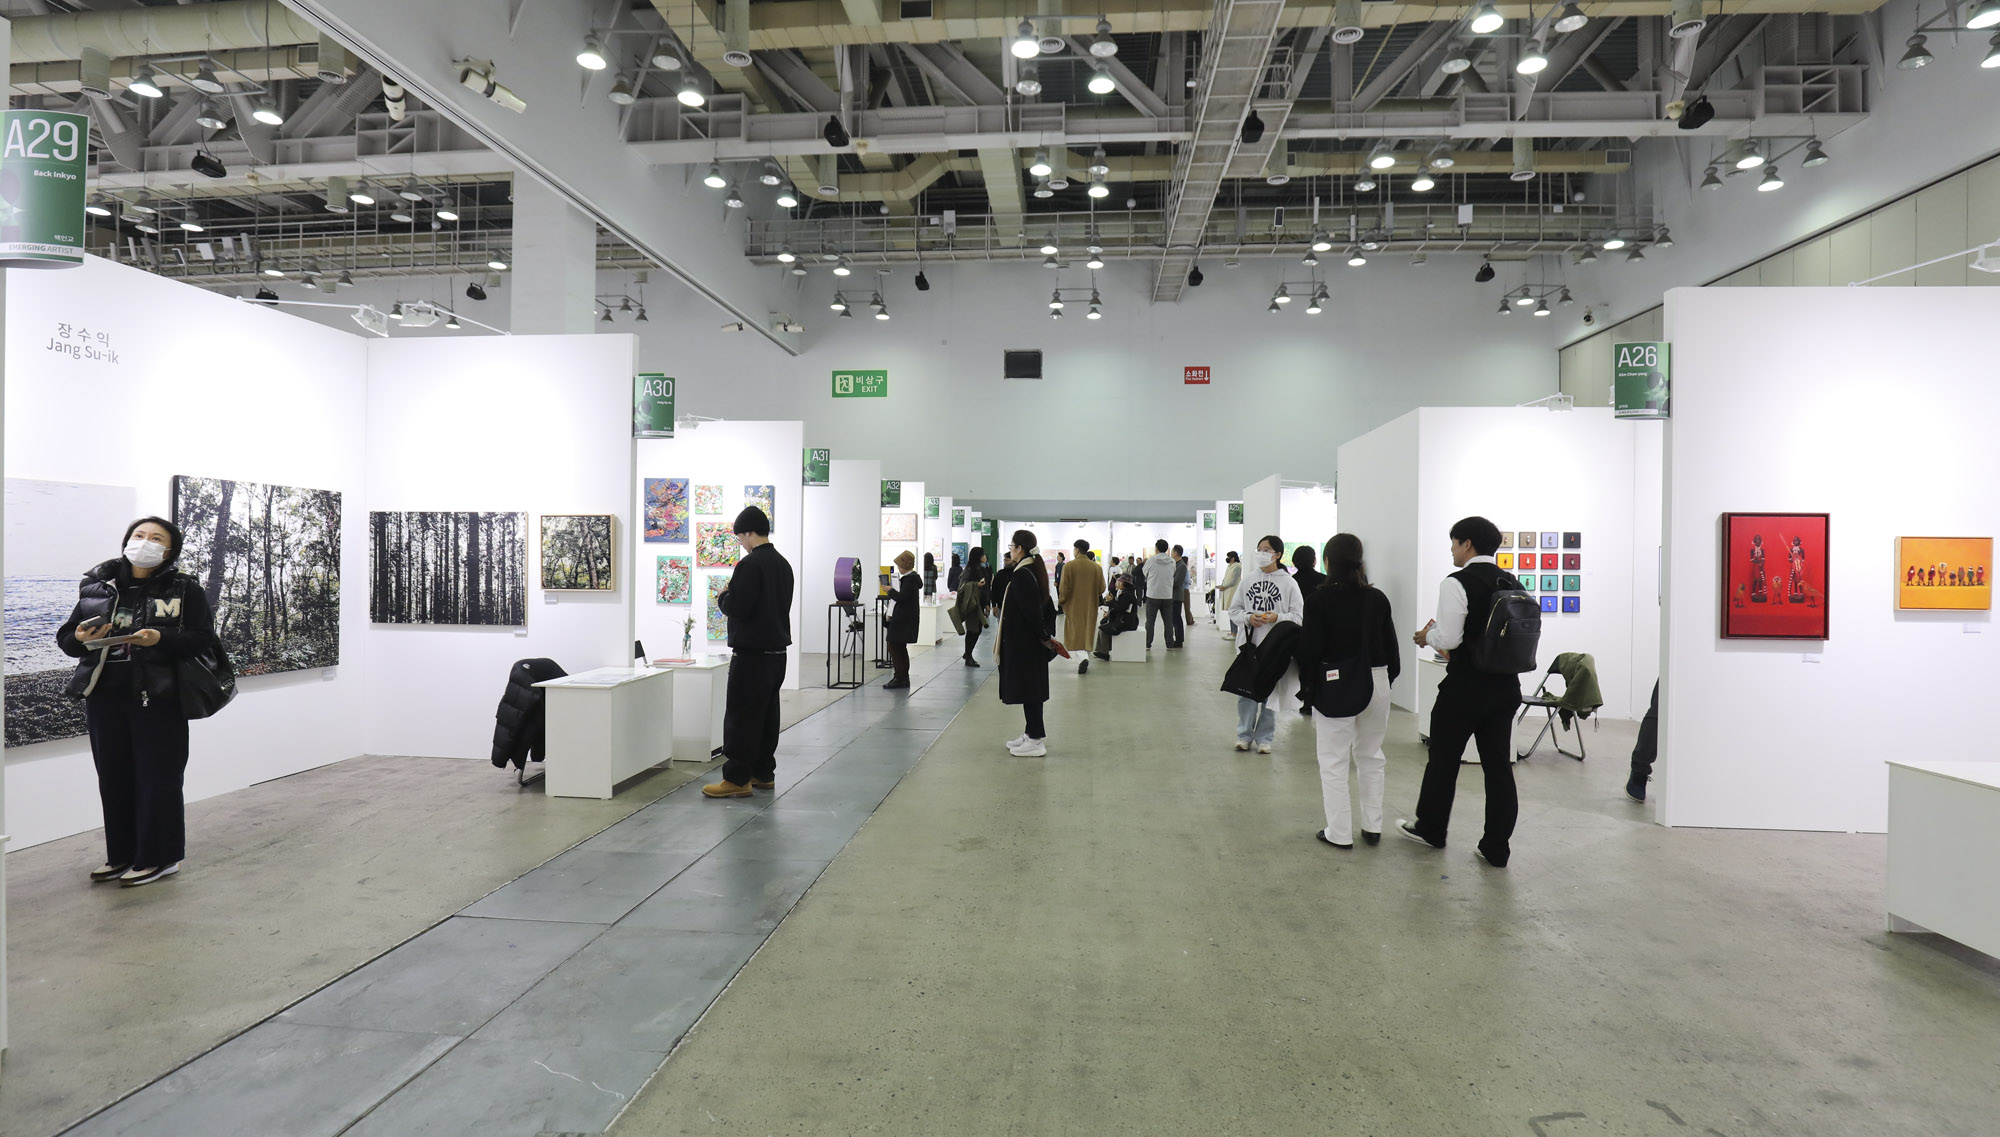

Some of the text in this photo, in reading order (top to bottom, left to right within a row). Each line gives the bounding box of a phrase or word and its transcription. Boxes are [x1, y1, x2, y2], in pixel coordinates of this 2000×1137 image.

[4, 118, 79, 162] A29
[33, 169, 77, 181] Back Inkyo
[9, 243, 74, 255] EMERGING ARTIST
[46, 337, 119, 365] Jang Su-ik
[1617, 345, 1657, 368] A26
[855, 375, 884, 385] 비상구
[1185, 370, 1204, 378] 소화전
[643, 379, 673, 397] A30
[861, 385, 878, 393] EXIT
[812, 450, 828, 461] A31
[886, 481, 900, 490] A32
[154, 598, 182, 618] M
